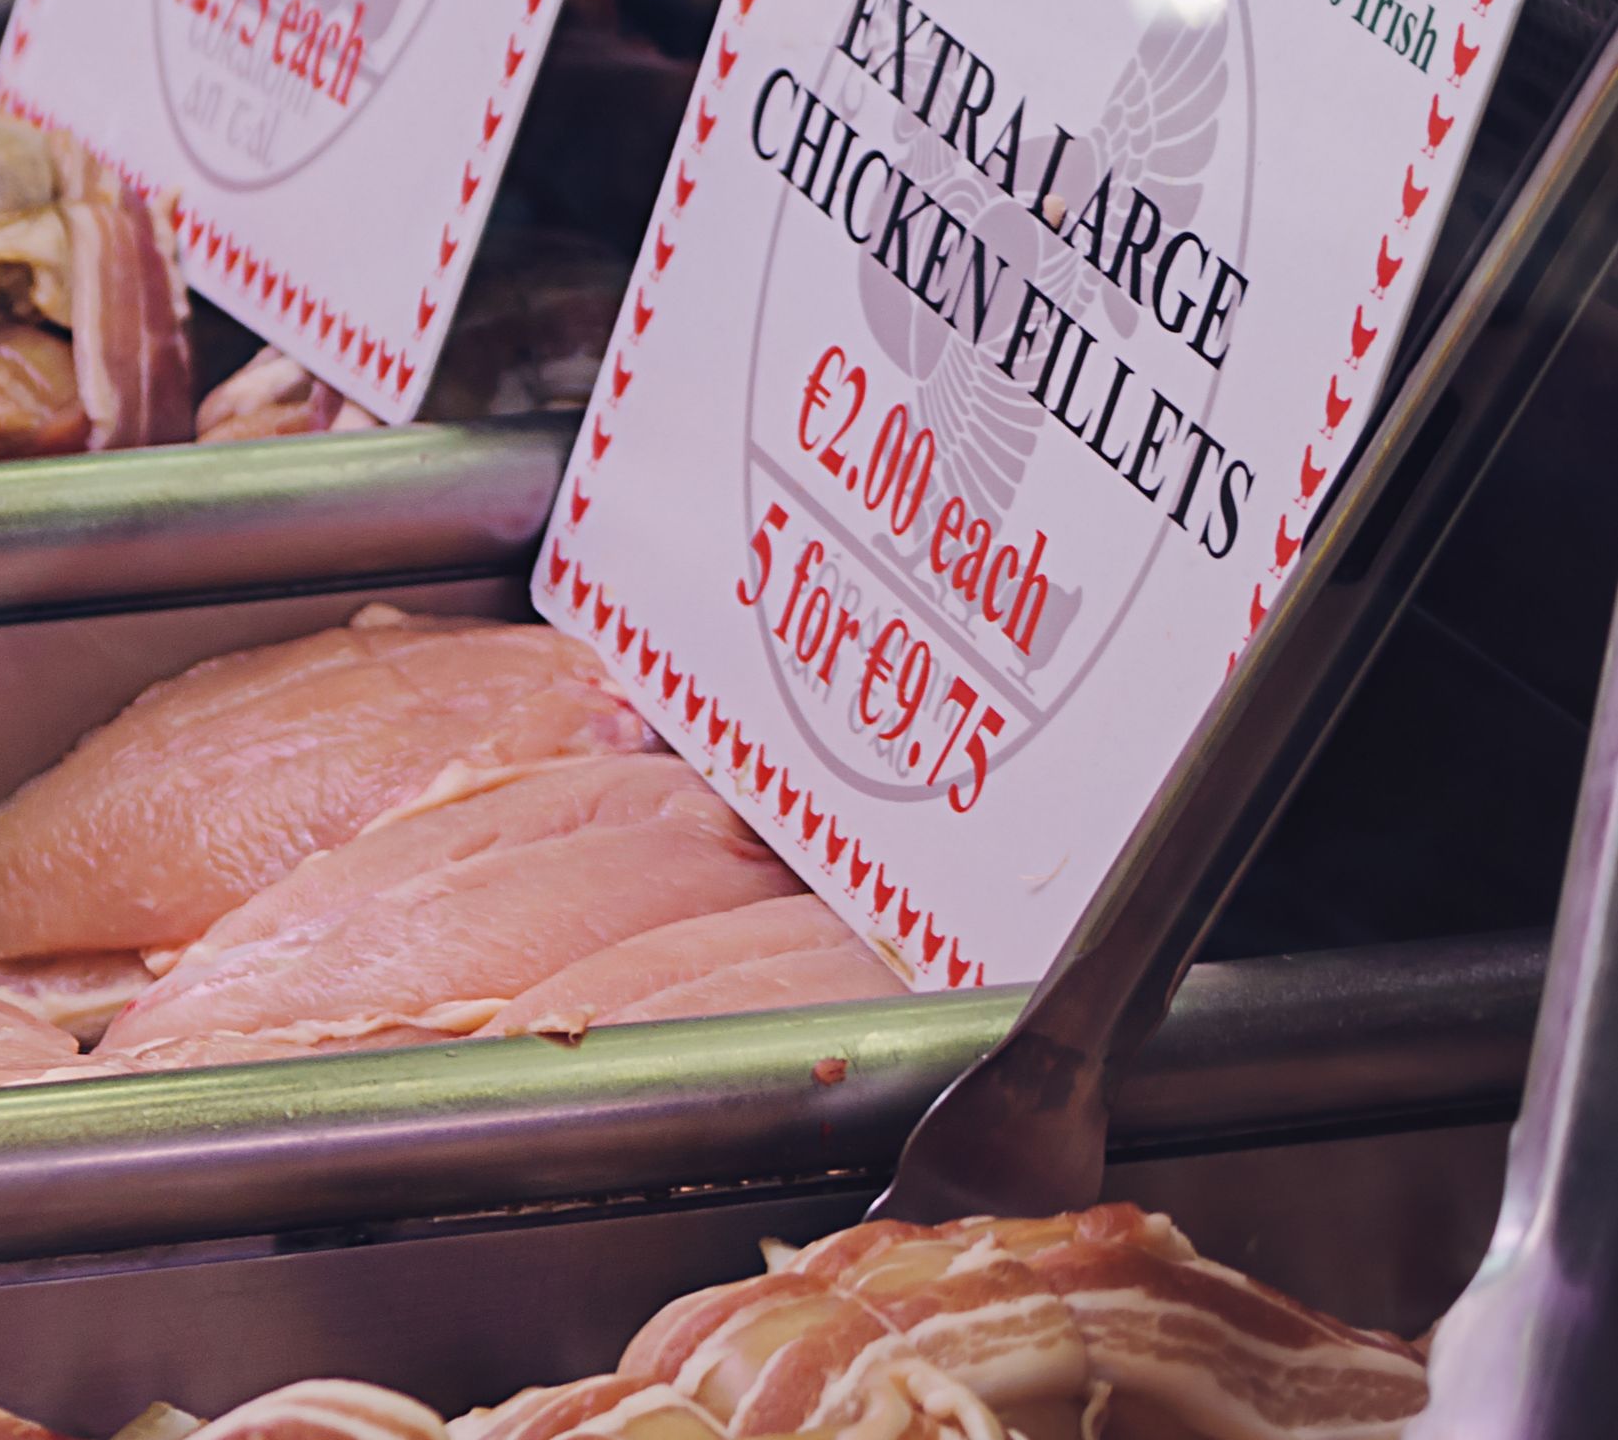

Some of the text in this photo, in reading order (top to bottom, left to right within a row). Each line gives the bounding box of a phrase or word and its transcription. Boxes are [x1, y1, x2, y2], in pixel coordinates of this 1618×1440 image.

[752, 68, 1255, 559] CHICKEN FILLETS
[1026, 125, 1249, 371] LARGE
[798, 345, 936, 537] €2.00
[929, 496, 1049, 656] each
[736, 502, 791, 607] 5
[772, 540, 861, 686] for
[858, 618, 1006, 814] €9.75
